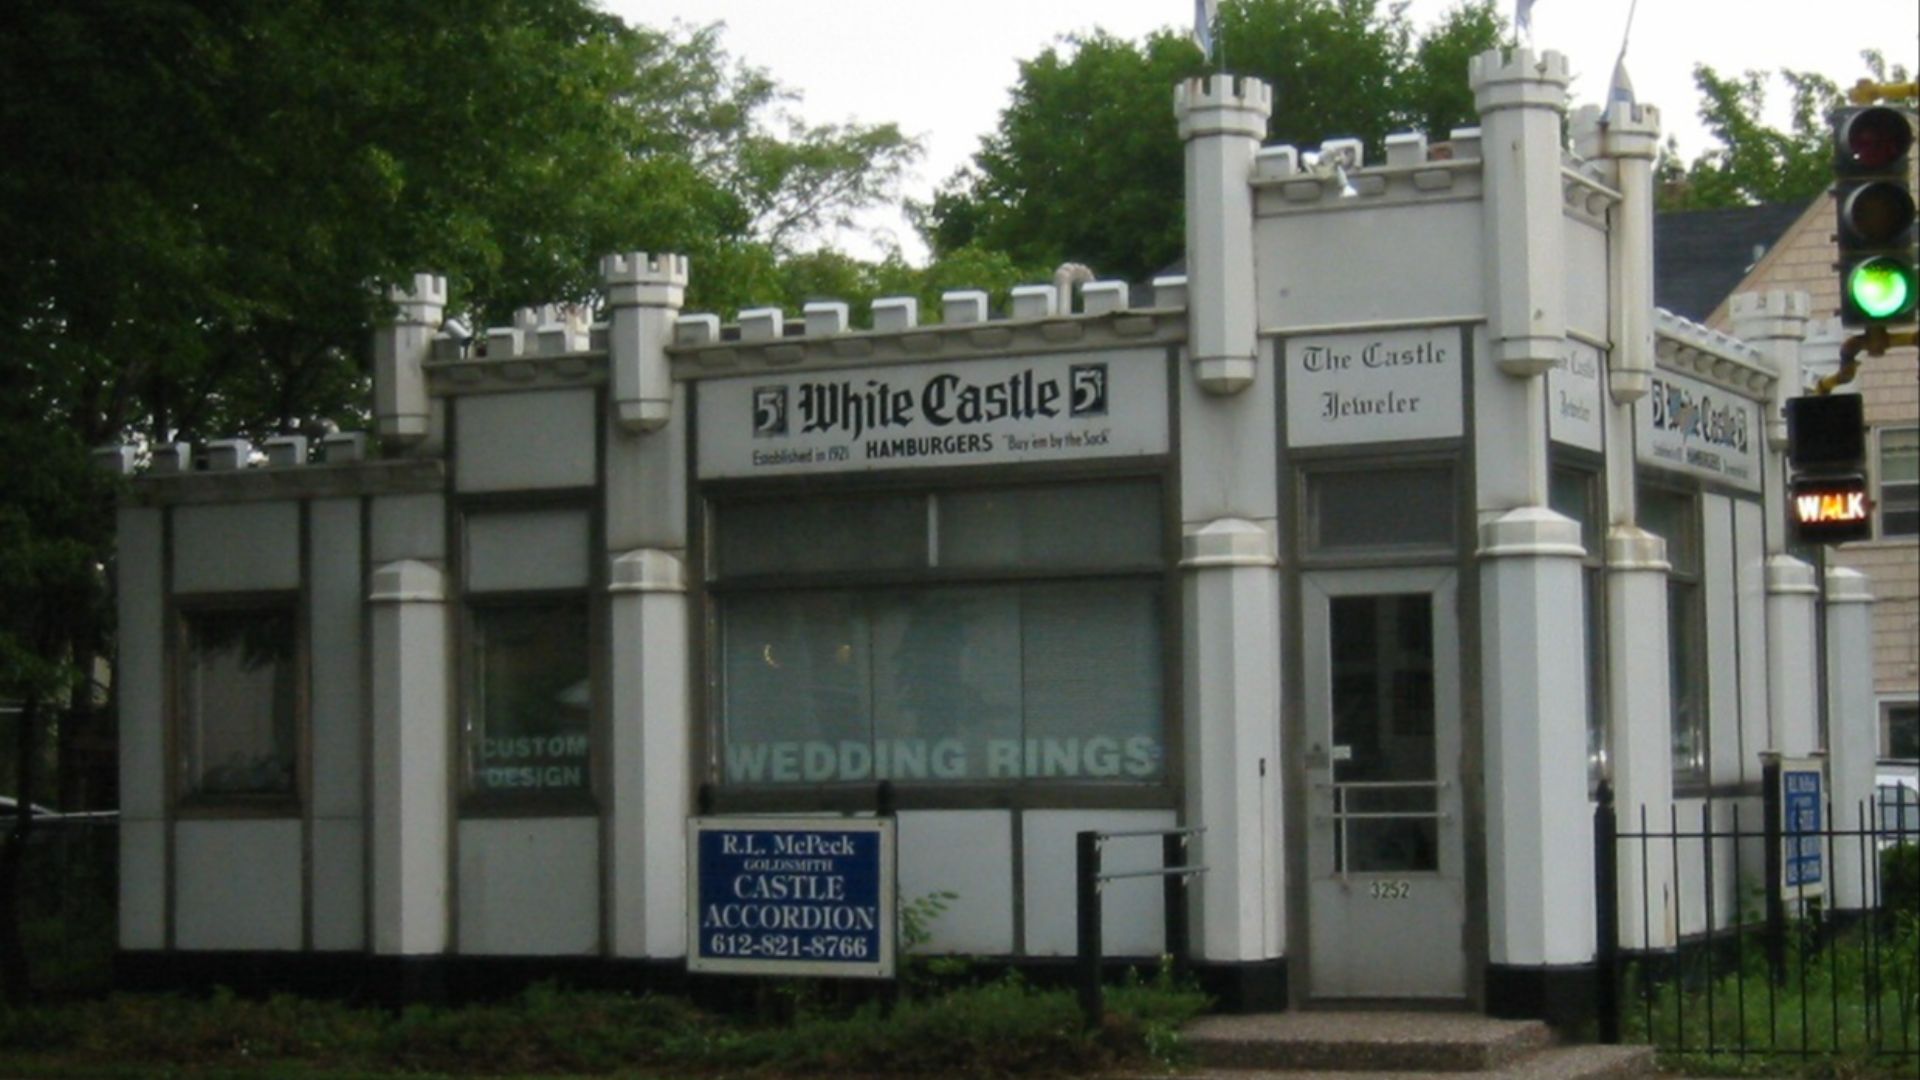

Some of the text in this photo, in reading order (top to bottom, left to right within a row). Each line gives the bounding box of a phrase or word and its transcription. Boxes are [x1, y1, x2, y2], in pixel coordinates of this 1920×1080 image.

[1303, 342, 1447, 372] The Castle
[798, 379, 913, 441] White
[922, 368, 1061, 427] Castle
[1322, 391, 1420, 421] Jeweler
[866, 432, 993, 459] HAMBURGERS
[1797, 492, 1865, 522] WALK
[482, 735, 588, 758] CUSTOM
[724, 735, 1157, 783] WEDDING RINGS
[486, 766, 581, 787] DESIGN
[722, 833, 855, 855] R.L. McPeck
[743, 859, 833, 871] GOLDSMITH
[733, 874, 845, 901] CASTLE
[1370, 881, 1410, 899] 3252
[703, 903, 876, 930] ACCORDION
[711, 934, 867, 958] 612-821-8766
